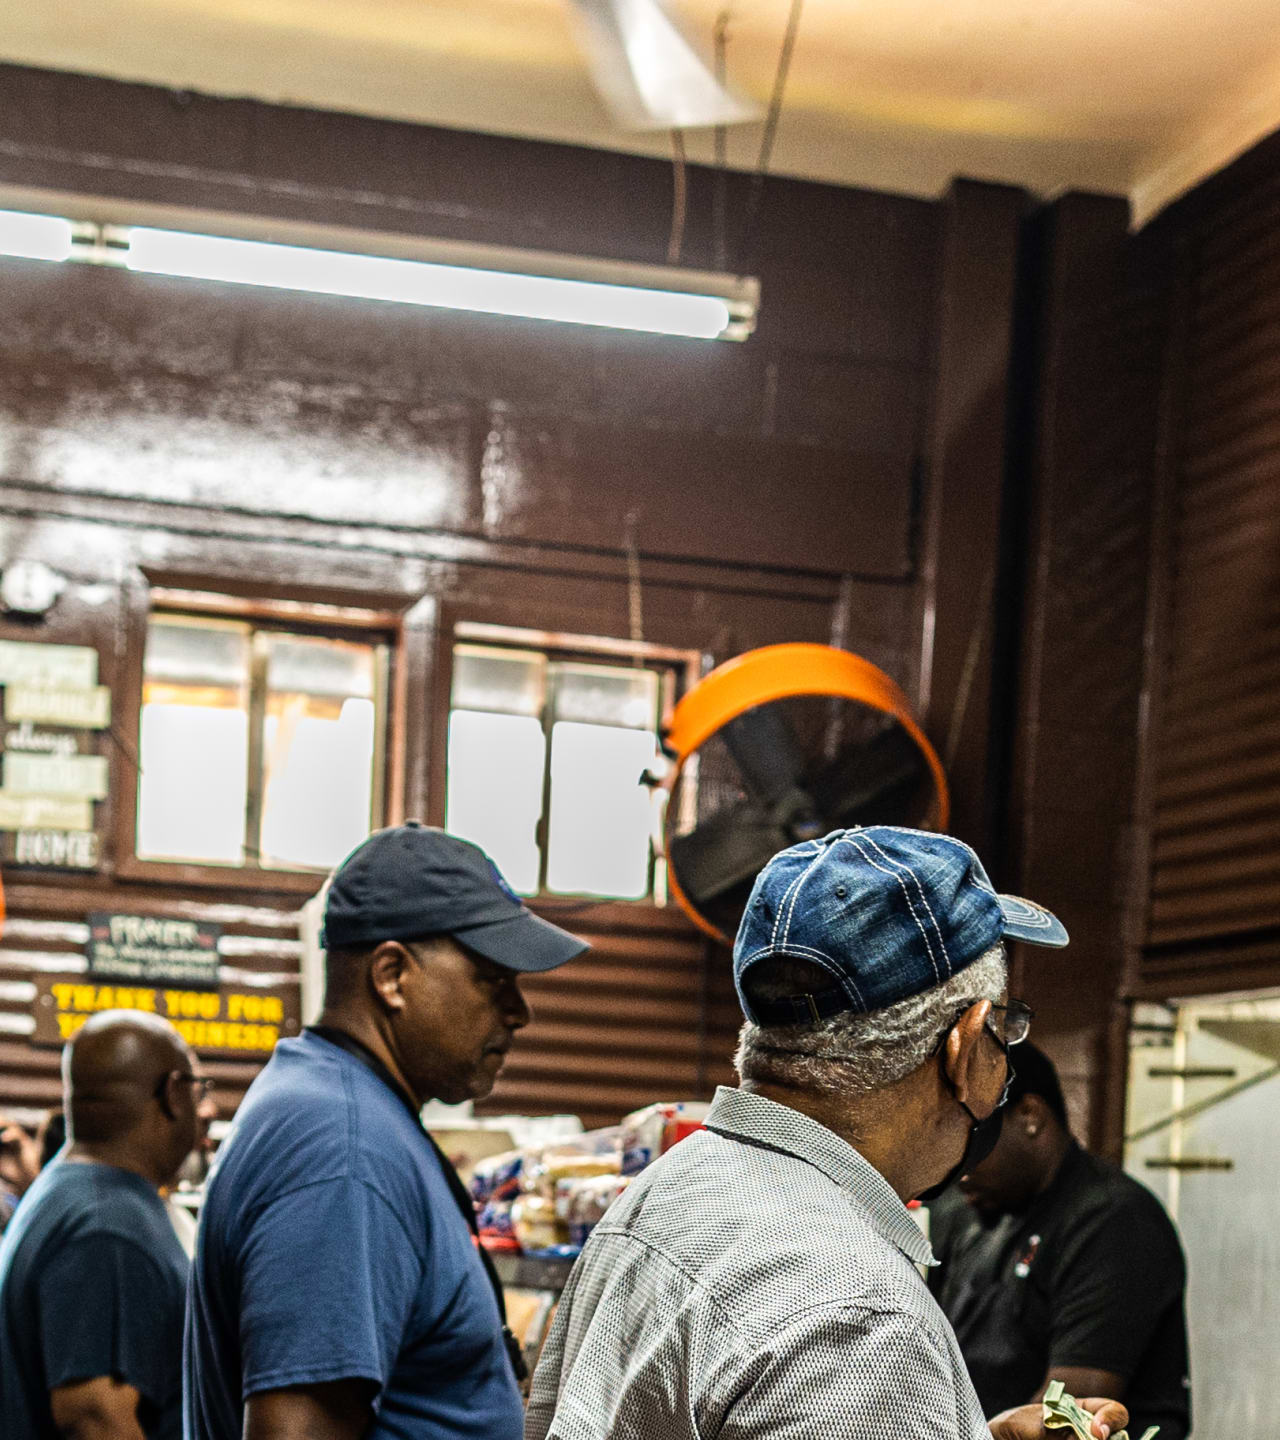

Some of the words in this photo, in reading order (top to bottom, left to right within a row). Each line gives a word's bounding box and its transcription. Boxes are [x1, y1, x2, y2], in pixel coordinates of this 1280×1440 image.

[16, 832, 98, 868] HOME
[51, 982, 157, 1012] THANK
[165, 990, 220, 1020] YOU
[227, 994, 283, 1024] FOR
